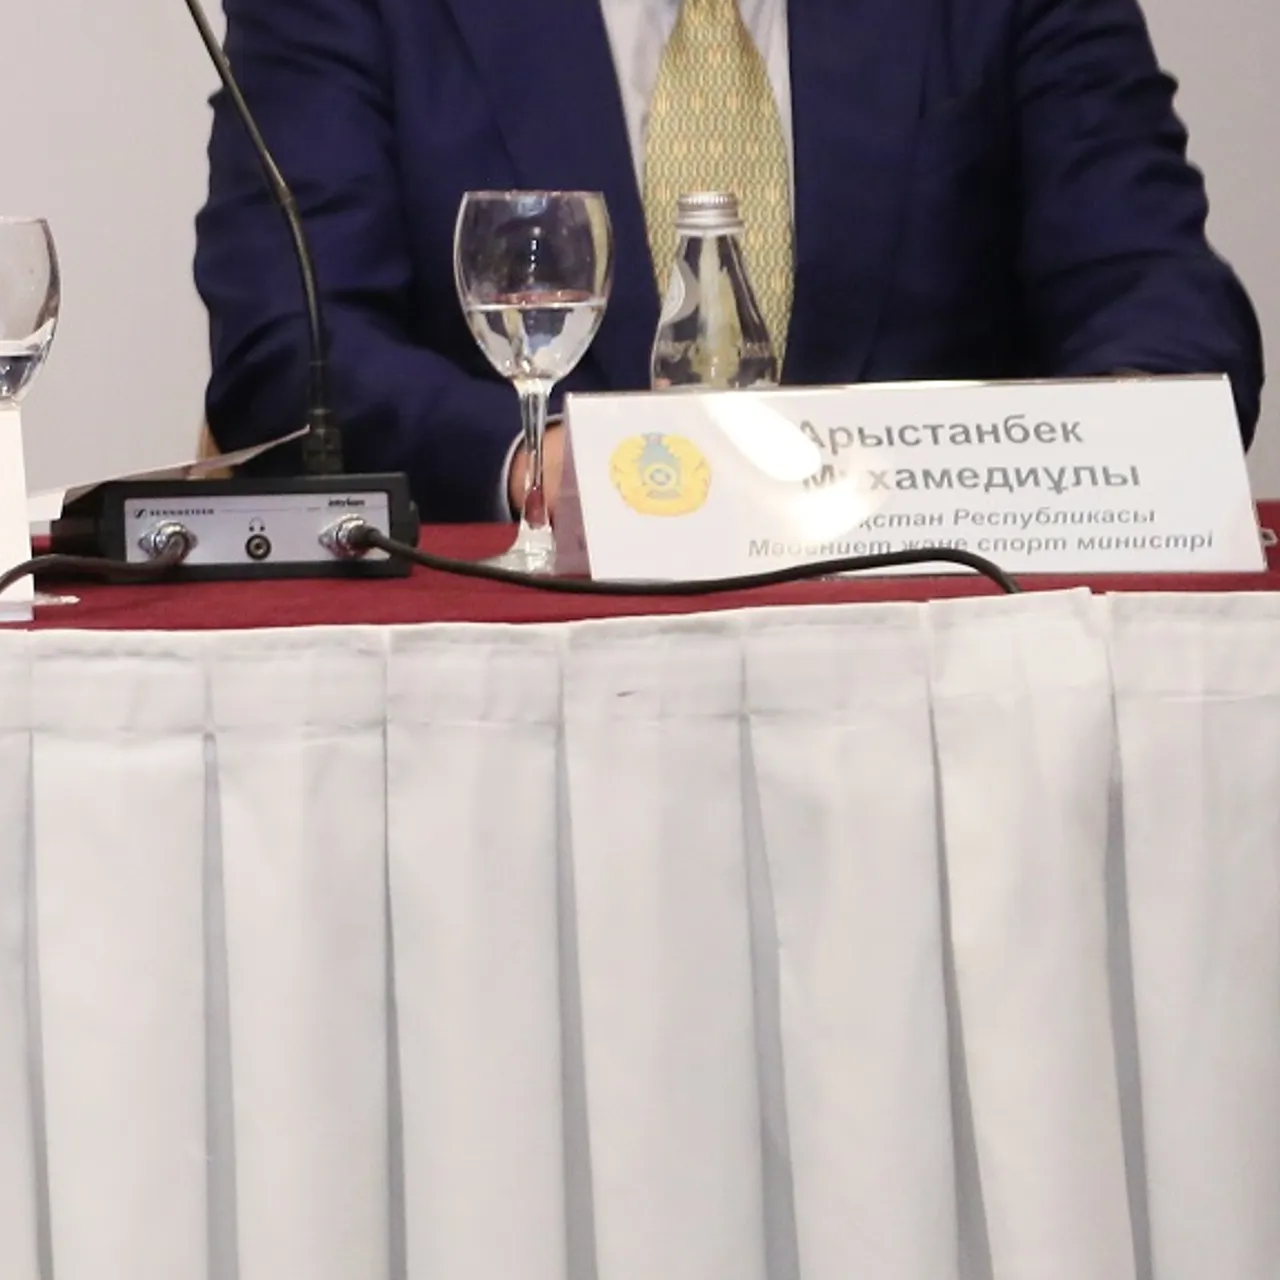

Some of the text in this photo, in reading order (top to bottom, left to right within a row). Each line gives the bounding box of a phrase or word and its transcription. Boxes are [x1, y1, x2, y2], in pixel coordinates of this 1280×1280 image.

[798, 414, 1084, 456] Арыстанбек
[801, 463, 1141, 495] Мхамедиұлы
[858, 506, 1156, 532] қстан Республикасы
[977, 535, 1067, 555] спорт
[1076, 530, 1214, 552] министрі
